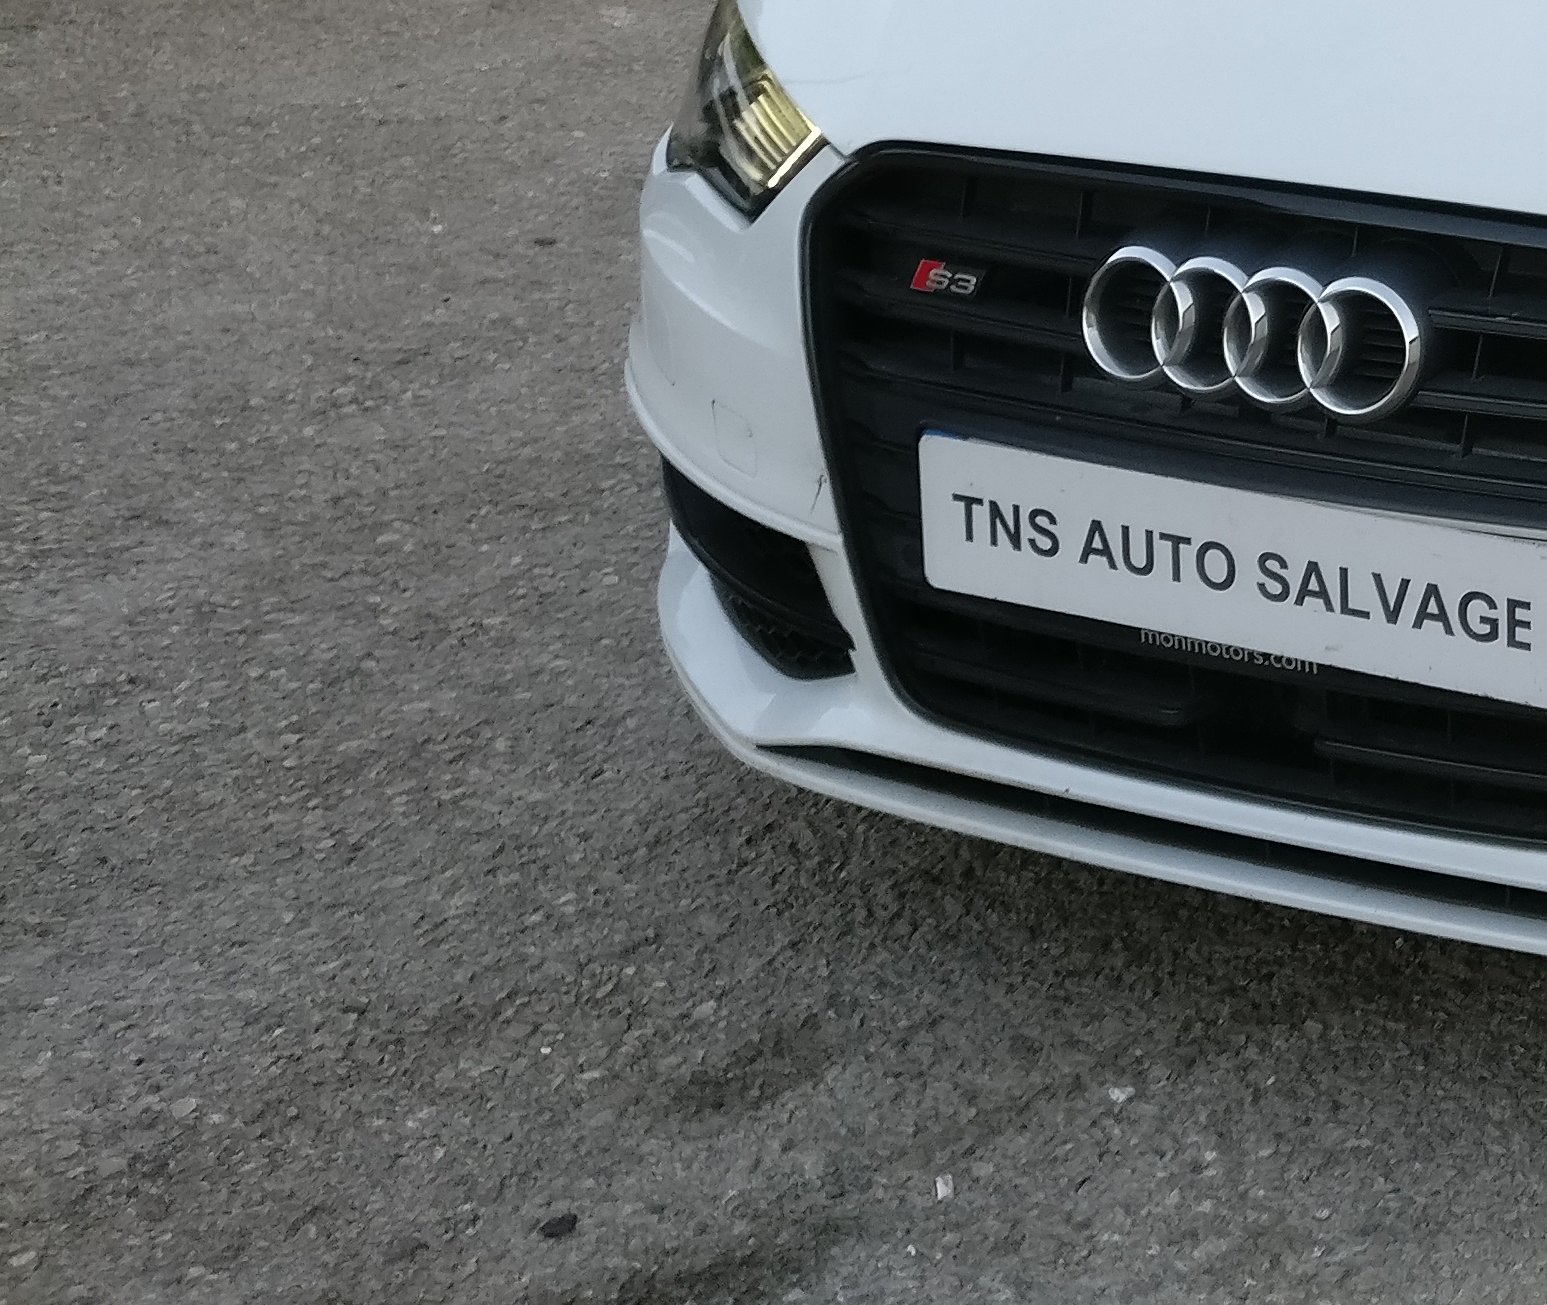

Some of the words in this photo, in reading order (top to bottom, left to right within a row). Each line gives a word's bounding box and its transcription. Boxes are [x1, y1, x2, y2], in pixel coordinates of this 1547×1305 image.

[925, 267, 977, 295] S3
[951, 492, 1060, 558] TNS
[1078, 518, 1237, 592] AUTO
[1256, 550, 1532, 653] SALVAGE
